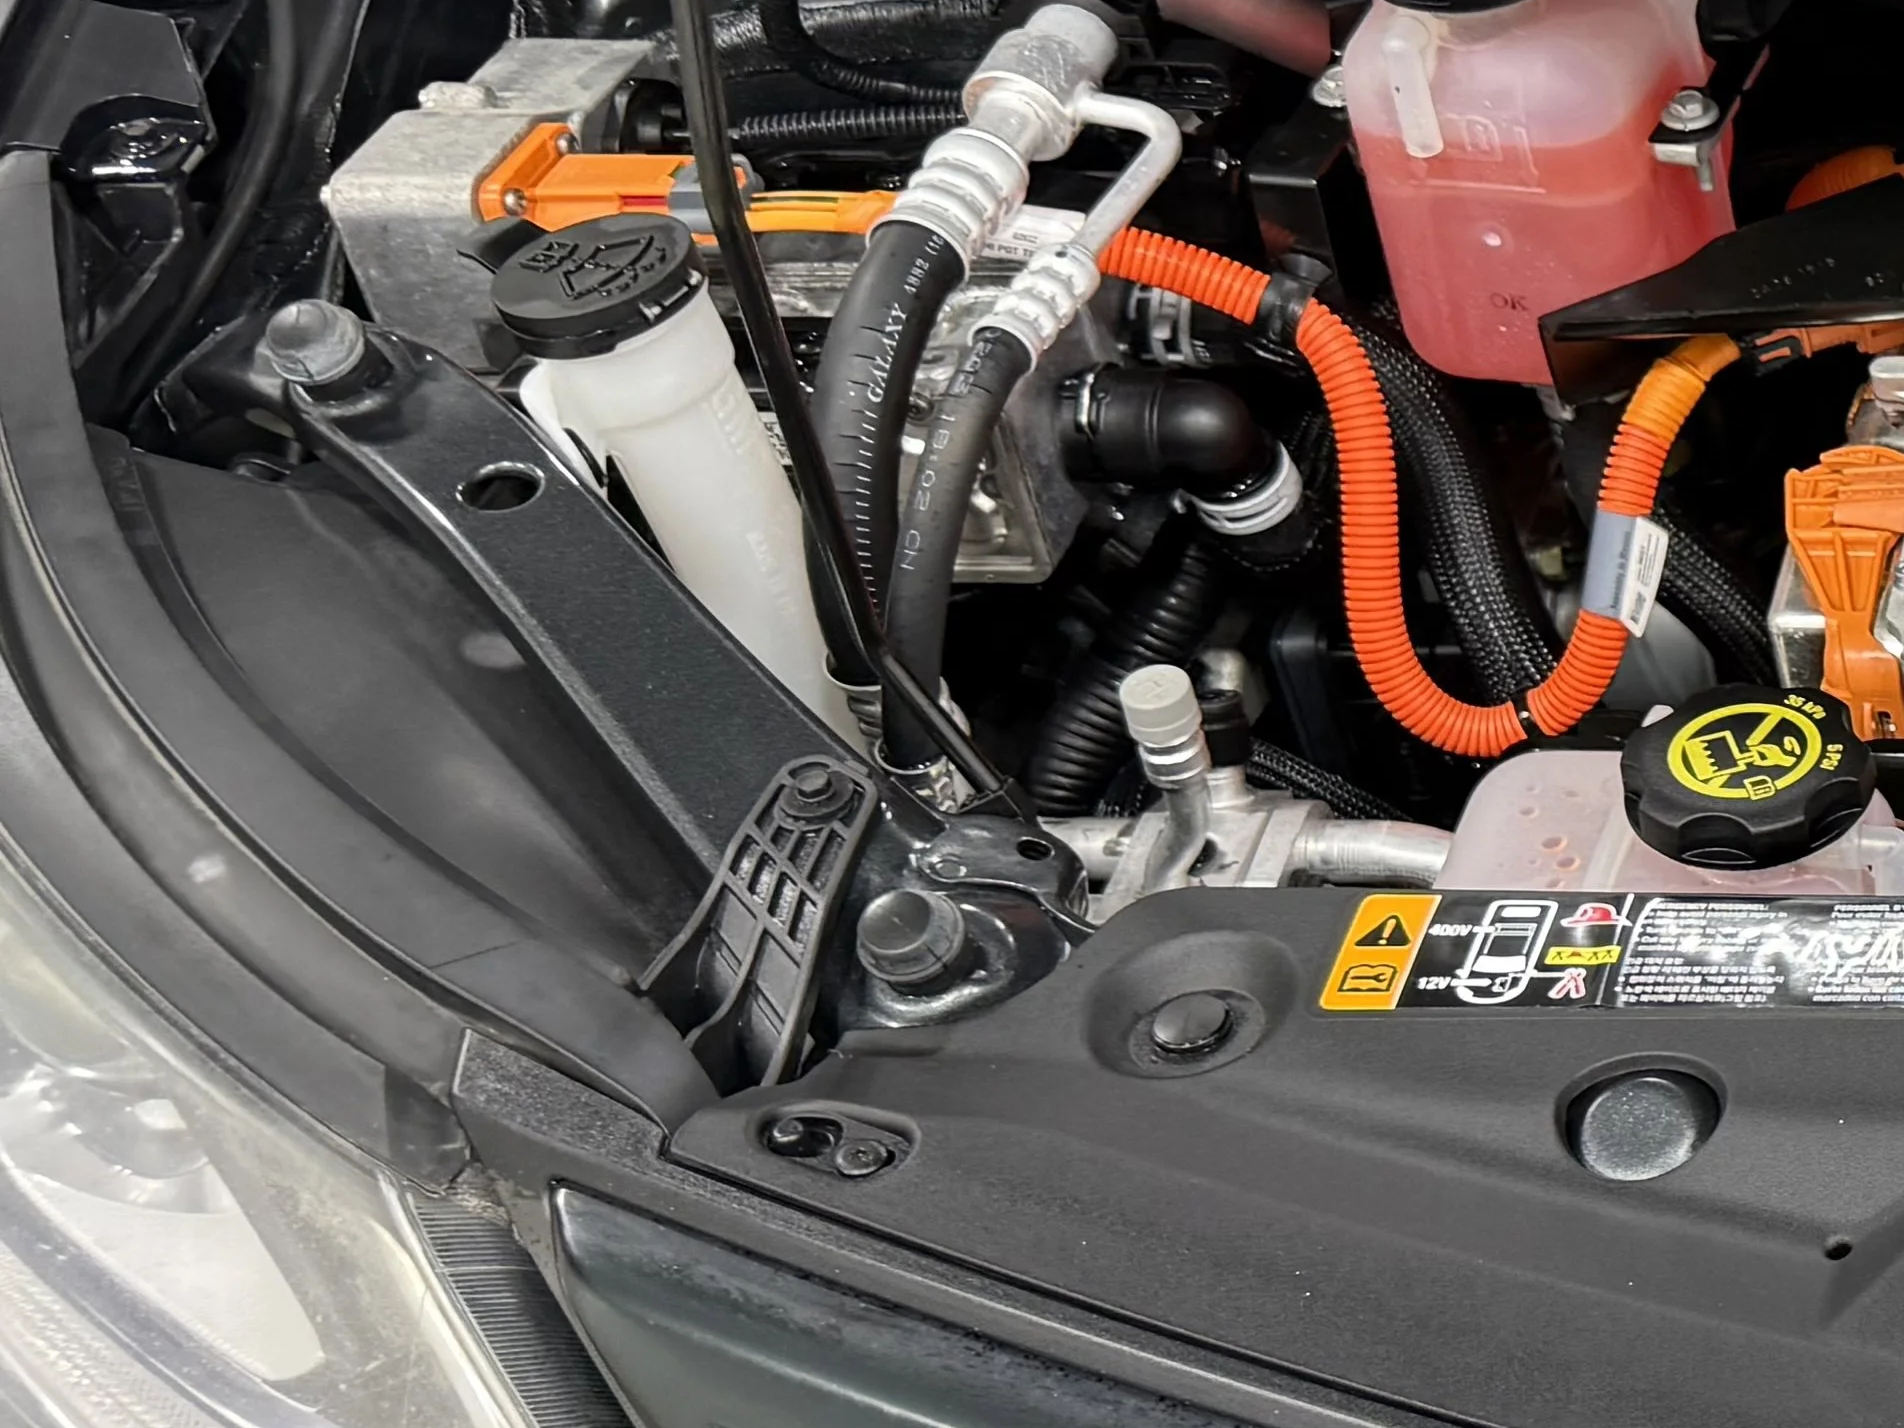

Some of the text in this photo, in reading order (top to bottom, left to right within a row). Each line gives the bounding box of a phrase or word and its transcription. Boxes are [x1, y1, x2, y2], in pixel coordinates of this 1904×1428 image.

[1490, 293, 1528, 312] OK
[867, 303, 908, 403] GALAXY
[904, 258, 930, 296] 4882
[1784, 694, 1806, 707] 35
[1428, 923, 1471, 936] 400V
[1416, 977, 1452, 990] 12V
